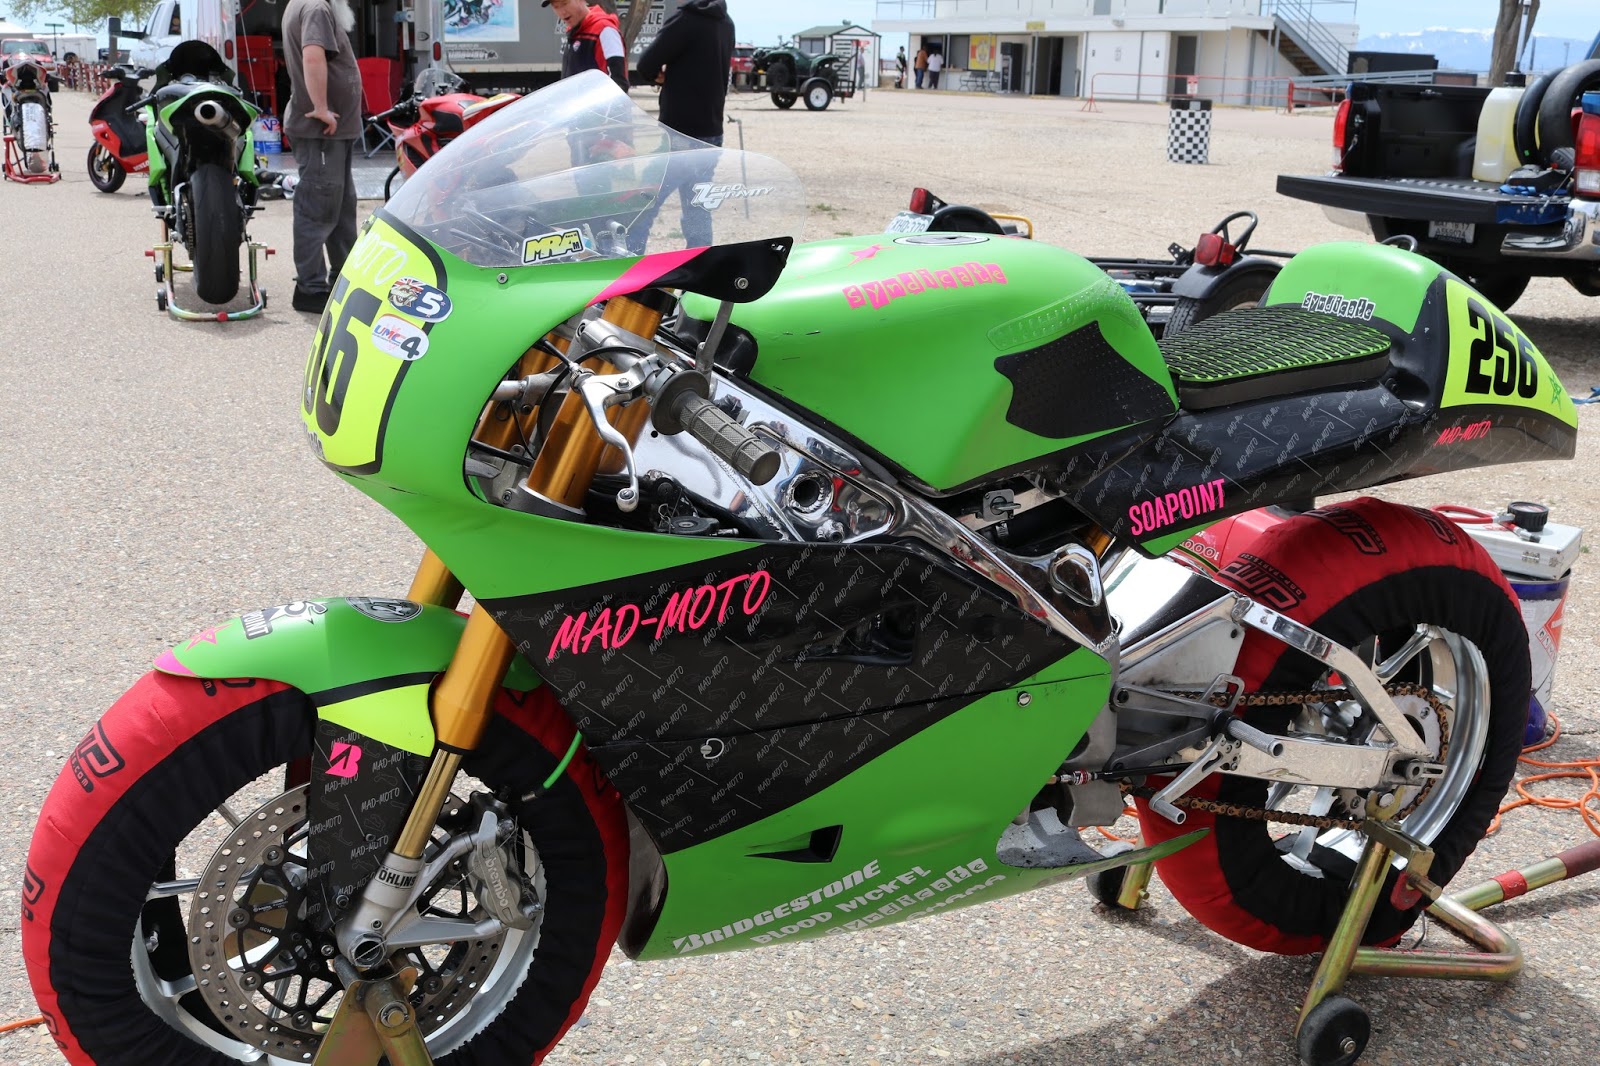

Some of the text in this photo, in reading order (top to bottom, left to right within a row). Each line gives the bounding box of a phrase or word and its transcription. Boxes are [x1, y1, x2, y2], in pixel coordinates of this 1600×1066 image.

[703, 185, 776, 212] GRAVITY
[524, 231, 583, 263] MRA
[842, 262, 1008, 310] syndicate
[416, 292, 444, 316] 5
[1301, 291, 1375, 320] syndicate
[374, 325, 405, 344] UMC
[400, 336, 421, 359] 4
[1465, 297, 1538, 399] 256
[1276, 432, 1300, 467] MAD-MOTO
[1311, 421, 1335, 455] MAD-MOTO
[1353, 417, 1377, 451] MAD-MOTO
[1434, 420, 1492, 447] MAD-MOTO
[1163, 454, 1184, 489] MAD-MOTO
[1200, 446, 1222, 481] MAD-MOTO
[1236, 437, 1259, 471] MAD-MOTO
[1131, 464, 1152, 500] MAD-MOTO
[1128, 478, 1225, 536] SOAPOINT
[834, 565, 864, 607] MAD-MOTO
[880, 557, 910, 597] MAD-MOTO
[547, 571, 771, 660] MAD-MOTO
[747, 591, 778, 636] MAD-MOTO
[795, 582, 825, 624] MAD-MOTO
[920, 592, 948, 631] MAD-MOTO
[752, 645, 781, 684] MAD-MOTO
[921, 630, 949, 667] MAD-MOTO
[600, 674, 634, 709] MAD-MOTO
[652, 665, 685, 703] MAD-MOTO
[698, 655, 729, 694] MAD-MOTO
[803, 667, 832, 705] MAD-MOTO
[715, 691, 746, 728] MAD-MOTO
[754, 683, 784, 720] MAD-MOTO
[611, 710, 646, 741] MAD-MOTO
[656, 703, 688, 737] MAD-MOTO
[659, 746, 693, 778] MAD-MOTO
[757, 760, 789, 794] MAD-MOTO
[804, 750, 834, 786] MAD-MOTO
[361, 788, 400, 812] MAD-MOTO
[660, 778, 694, 807] MAD-MOTO
[711, 771, 744, 803] MAD-MOTO
[350, 835, 389, 860] MAD-MOTO
[486, 856, 508, 907] brembo
[825, 858, 989, 935] syndicate
[673, 859, 882, 953] BRIDGESTONE
[750, 866, 932, 944] BLOOD NICKEL
